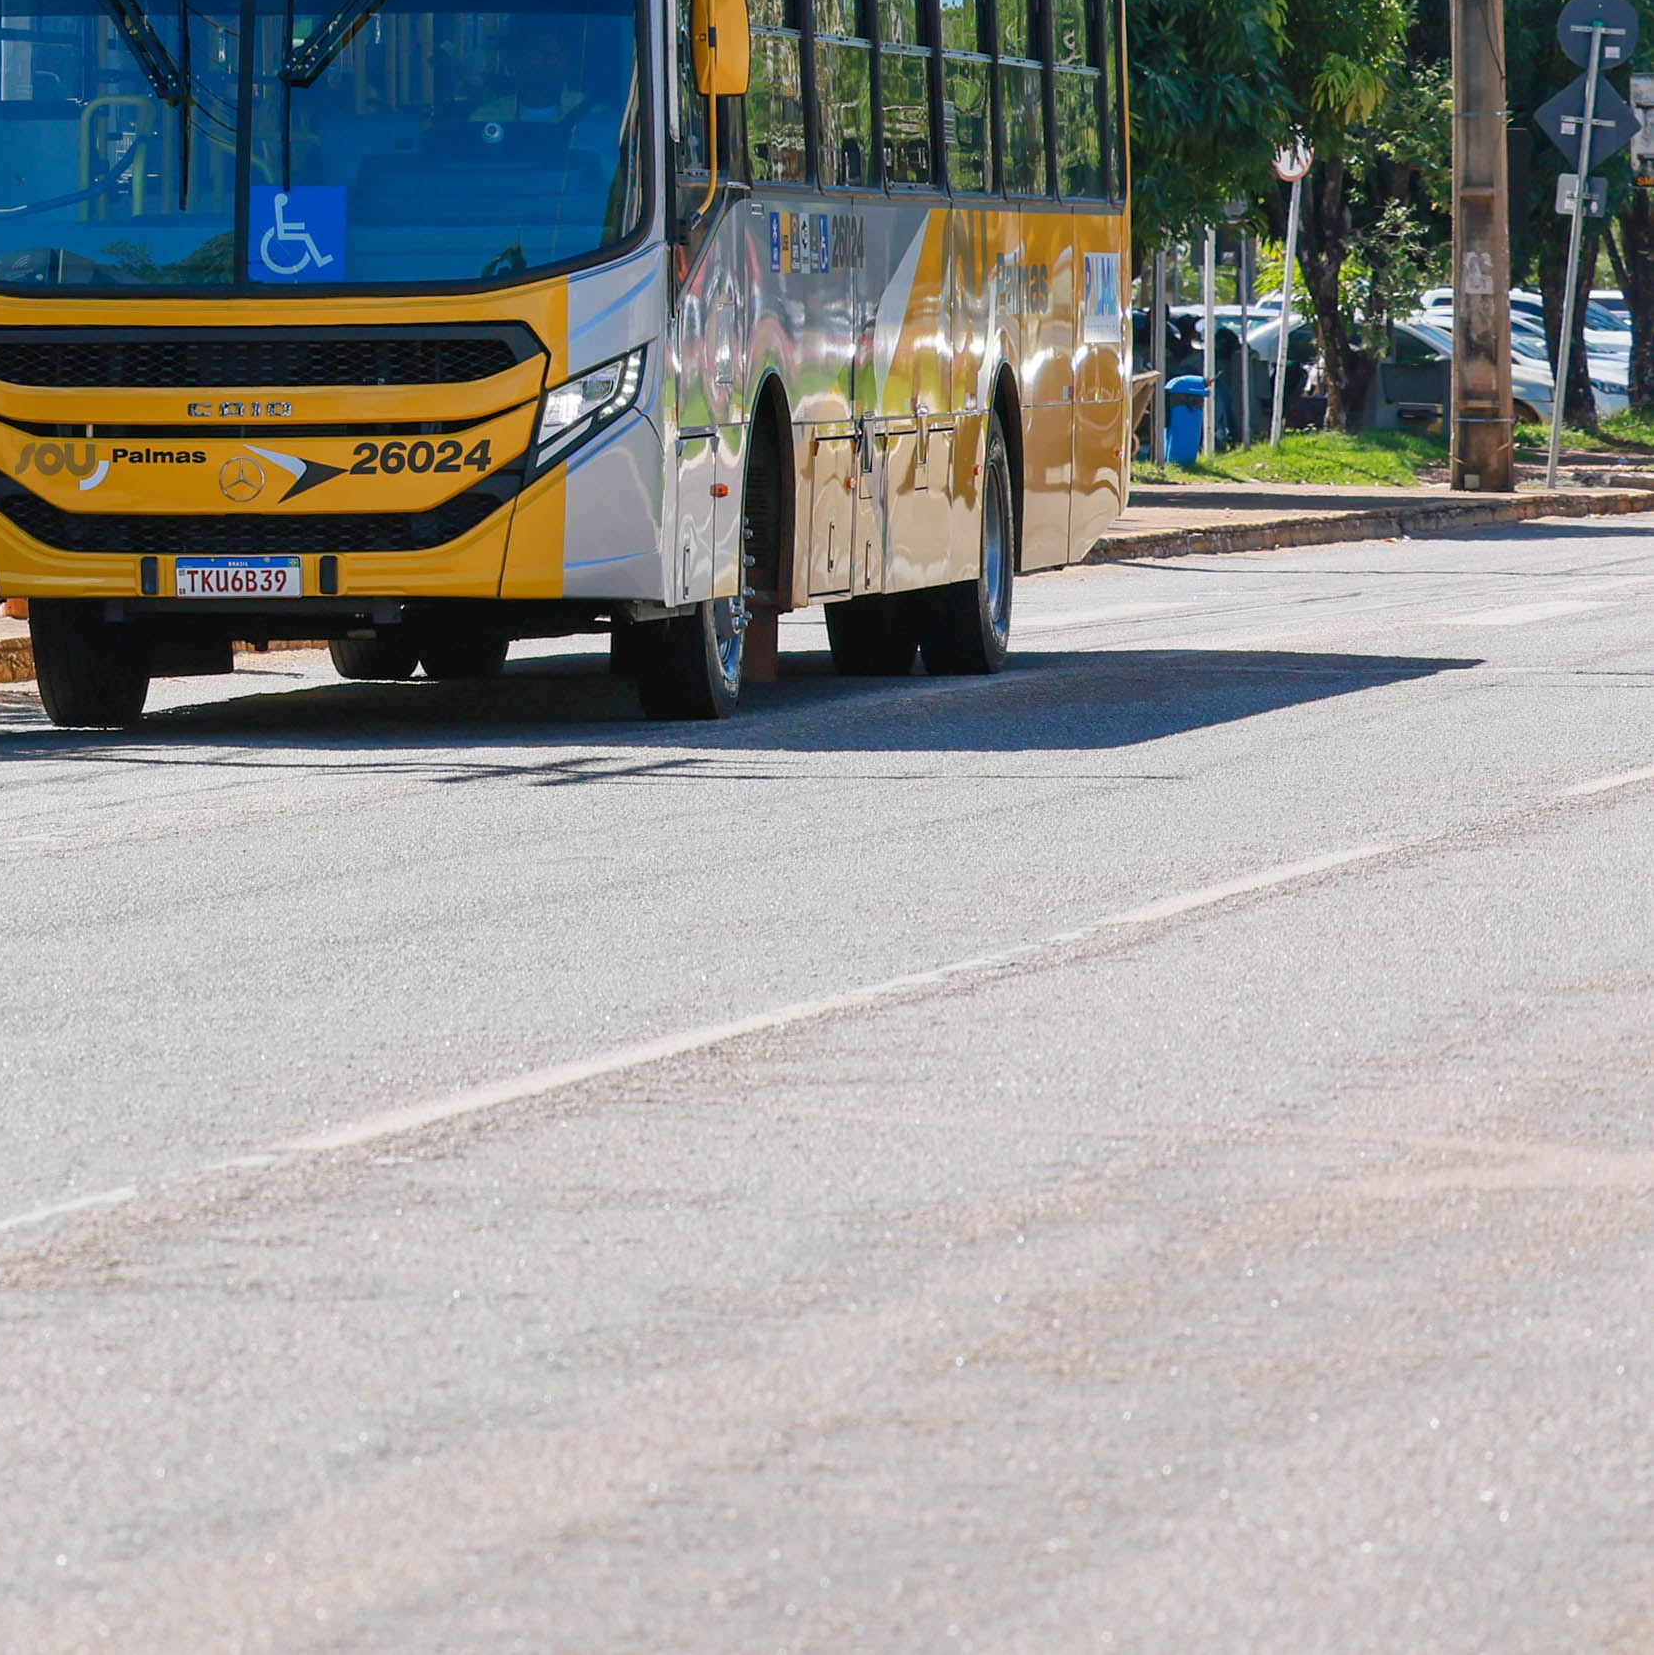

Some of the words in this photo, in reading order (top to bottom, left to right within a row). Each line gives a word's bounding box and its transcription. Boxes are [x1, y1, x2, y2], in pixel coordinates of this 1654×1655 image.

[112, 448, 206, 463] Palmas
[349, 439, 491, 474] 26024
[187, 569, 287, 593] TKU6B39
